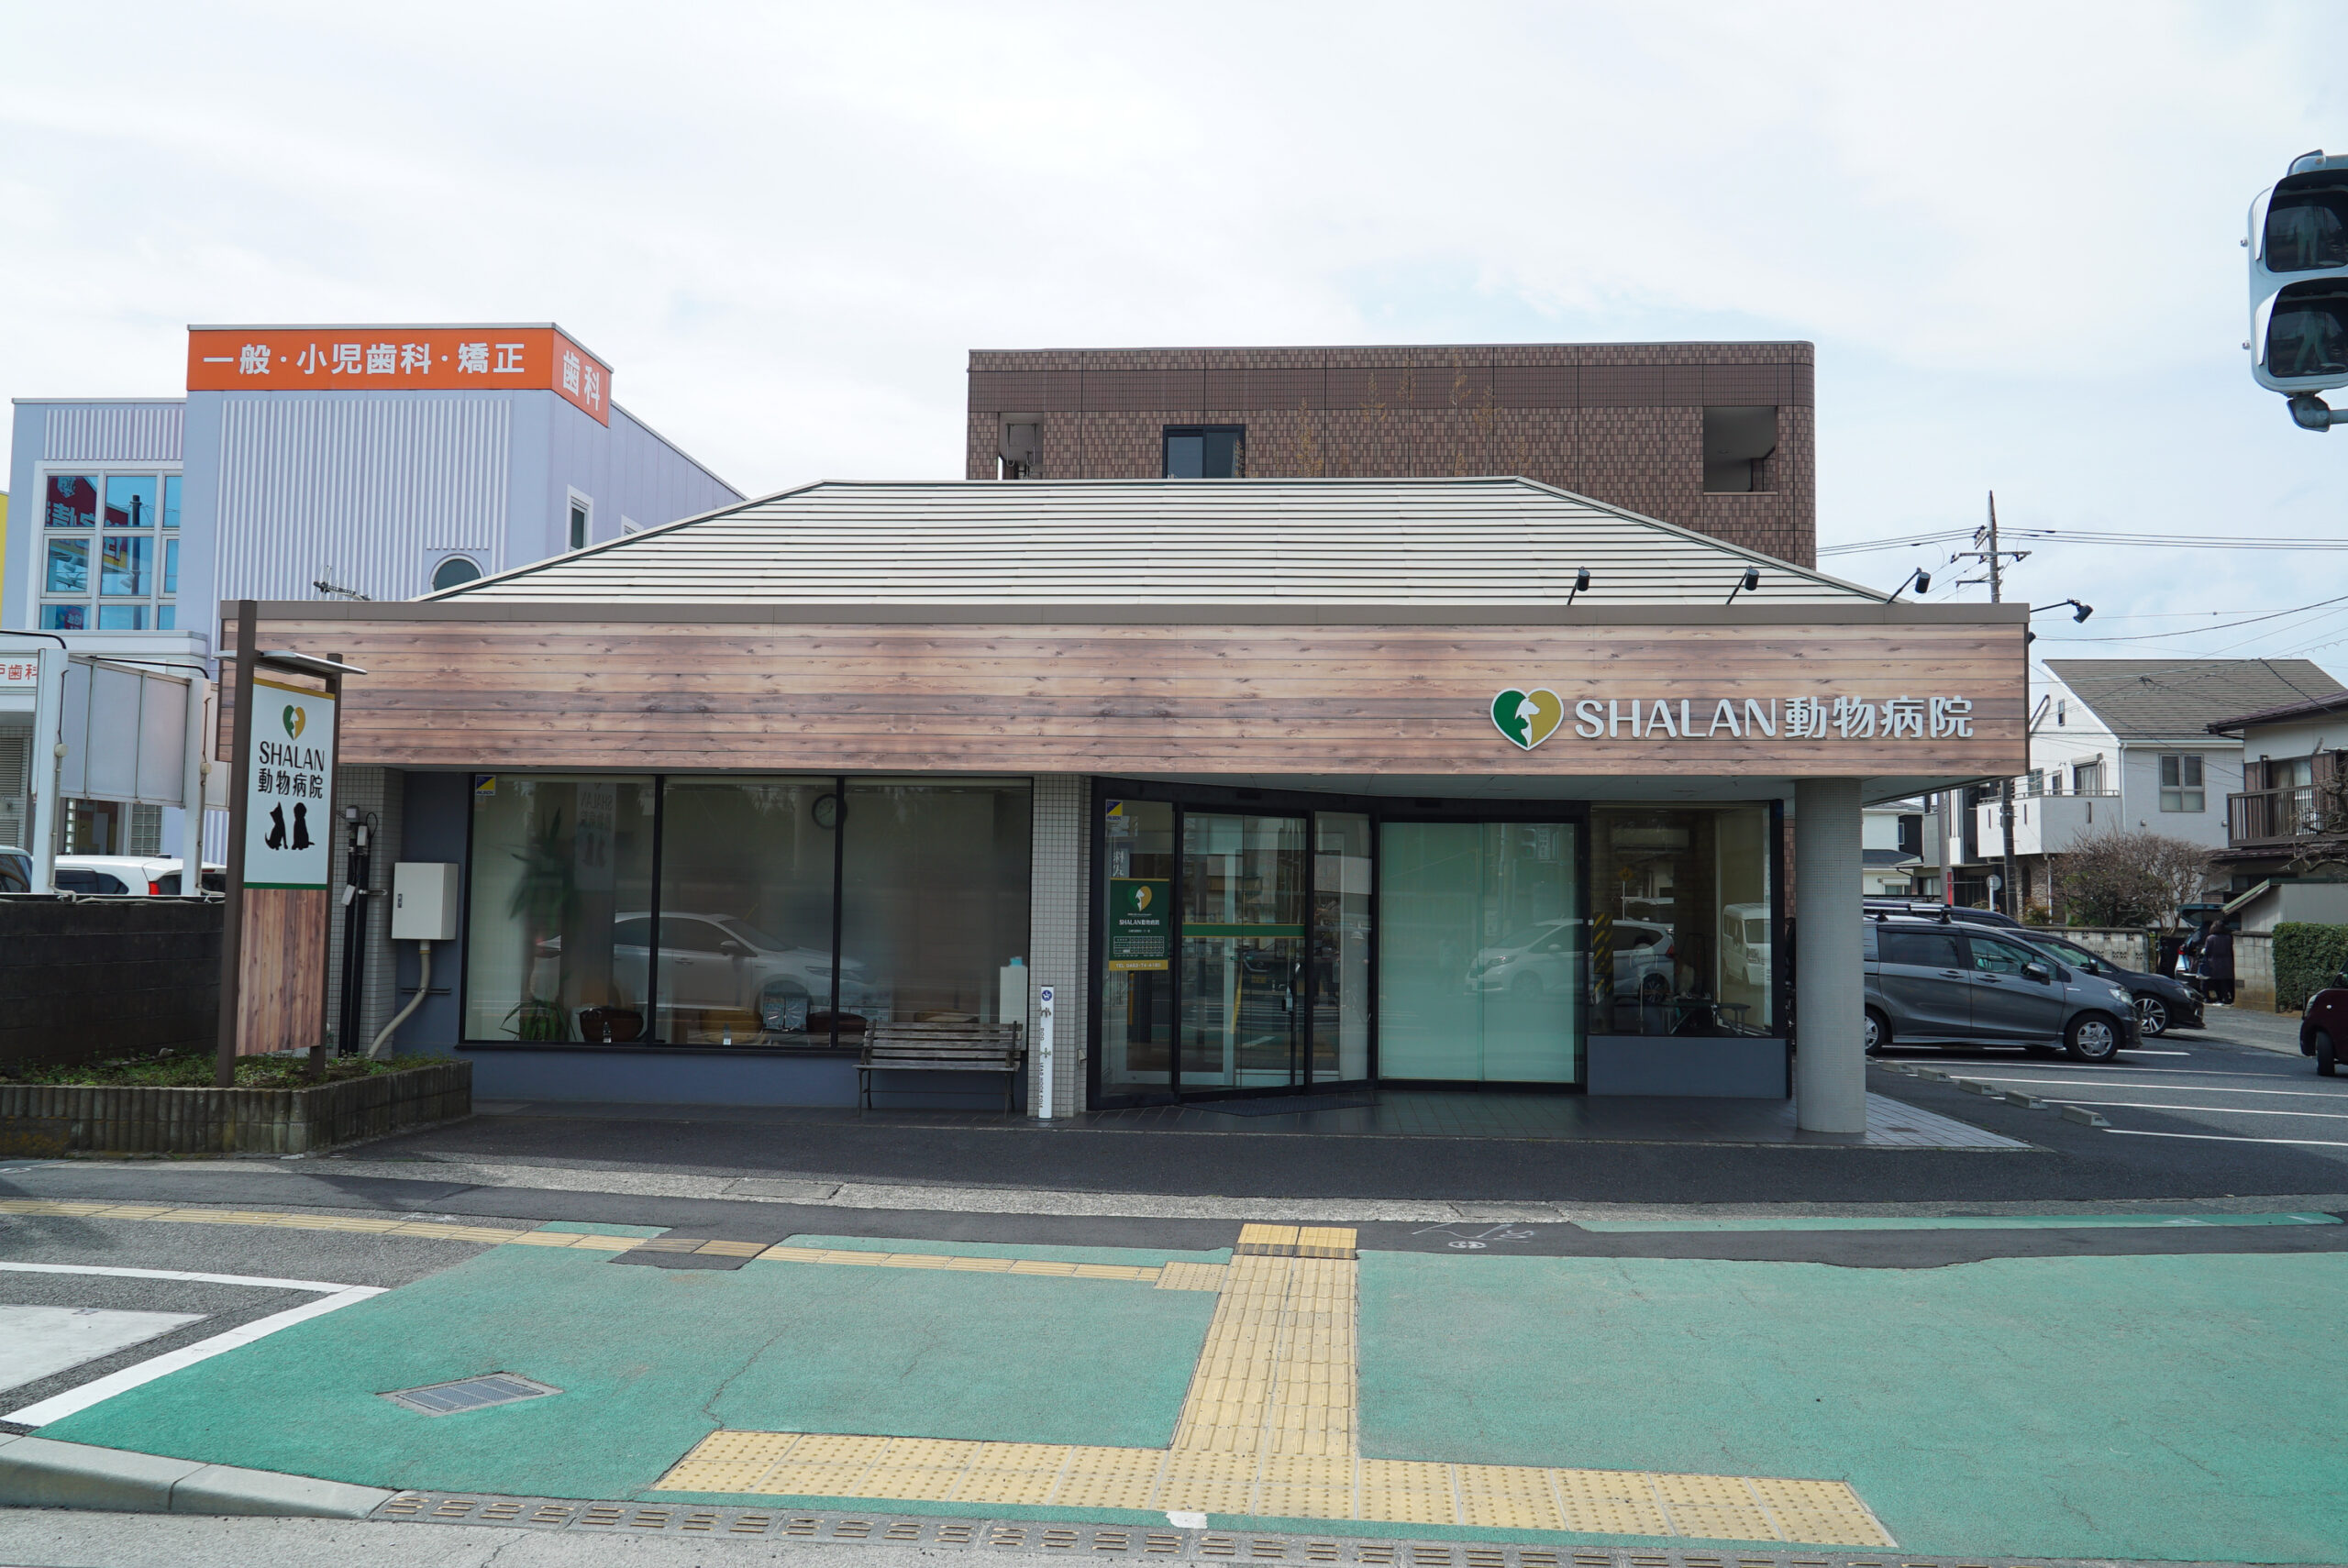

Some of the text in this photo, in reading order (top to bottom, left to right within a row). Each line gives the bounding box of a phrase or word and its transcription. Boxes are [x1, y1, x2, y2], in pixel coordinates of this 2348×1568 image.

[203, 342, 526, 375] 一般・小児歯科・矯正
[562, 349, 601, 411] 歯科
[1574, 694, 1975, 740] SHALAN動物病院
[259, 740, 325, 772] SHALAN
[258, 767, 323, 800] 動物病院
